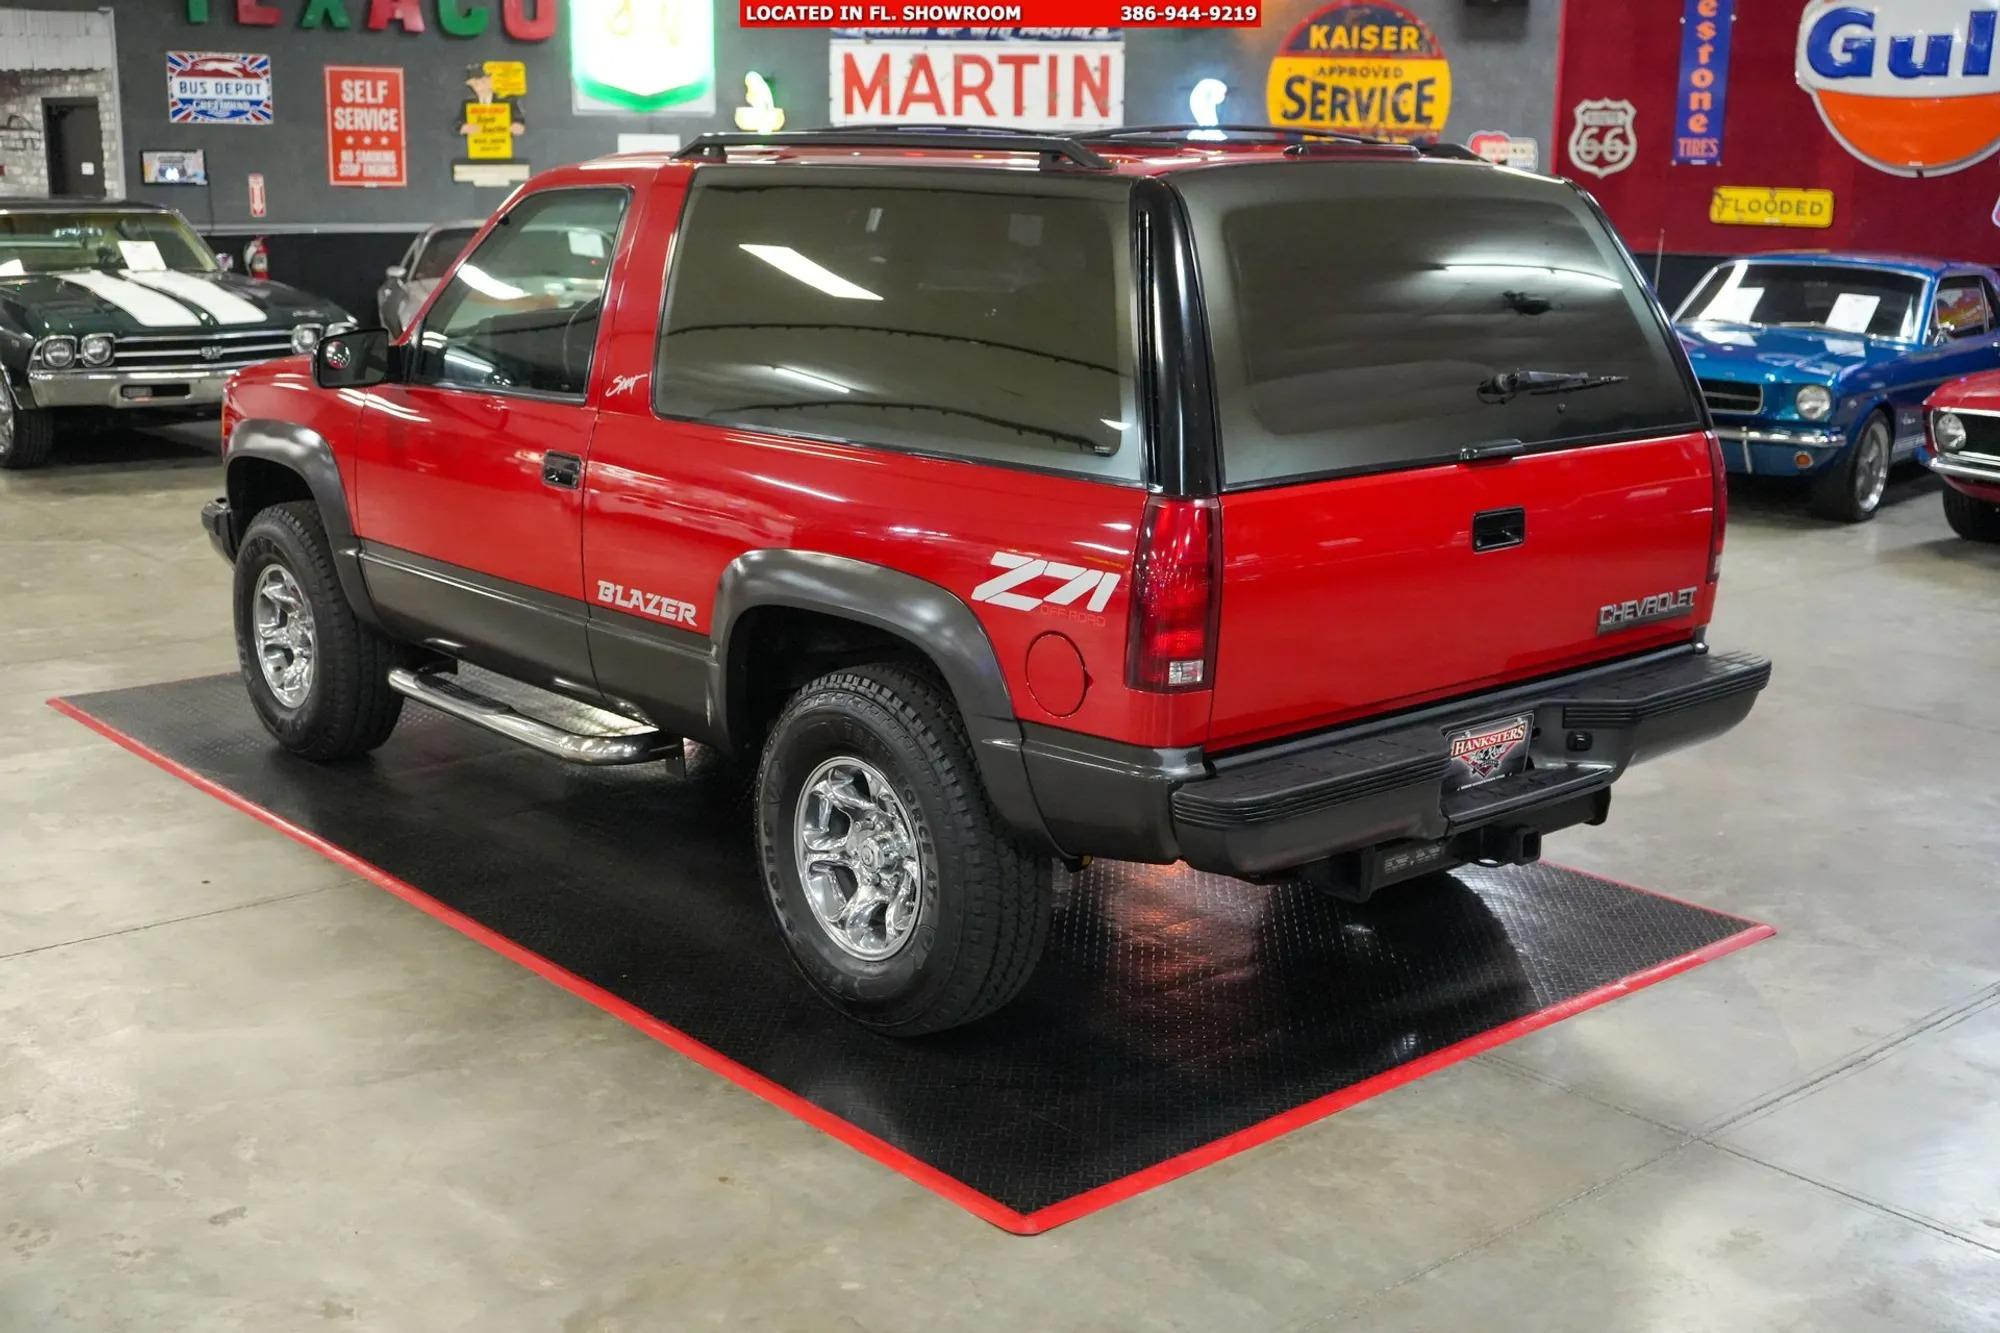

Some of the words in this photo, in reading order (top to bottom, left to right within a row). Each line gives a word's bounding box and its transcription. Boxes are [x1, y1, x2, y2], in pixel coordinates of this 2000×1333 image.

[187, 0, 556, 41] XACO
[1308, 23, 1421, 51] KAISER
[843, 52, 1110, 118] MARTIN
[1317, 65, 1404, 79] APPROVED
[179, 81, 207, 95] BUS
[215, 82, 262, 97] DEPOT
[341, 79, 388, 104] SELF
[1281, 74, 1436, 124] SERVICE
[334, 106, 399, 132] SERVICE
[1579, 127, 1624, 163] 66
[1678, 138, 1719, 158] TIRES
[1722, 197, 1824, 217] FLOODED
[970, 551, 1122, 613] Z71
[597, 579, 698, 628] BLAZER
[1600, 586, 1698, 625] CHEVROLET
[1453, 724, 1525, 757] HANKSTERS
